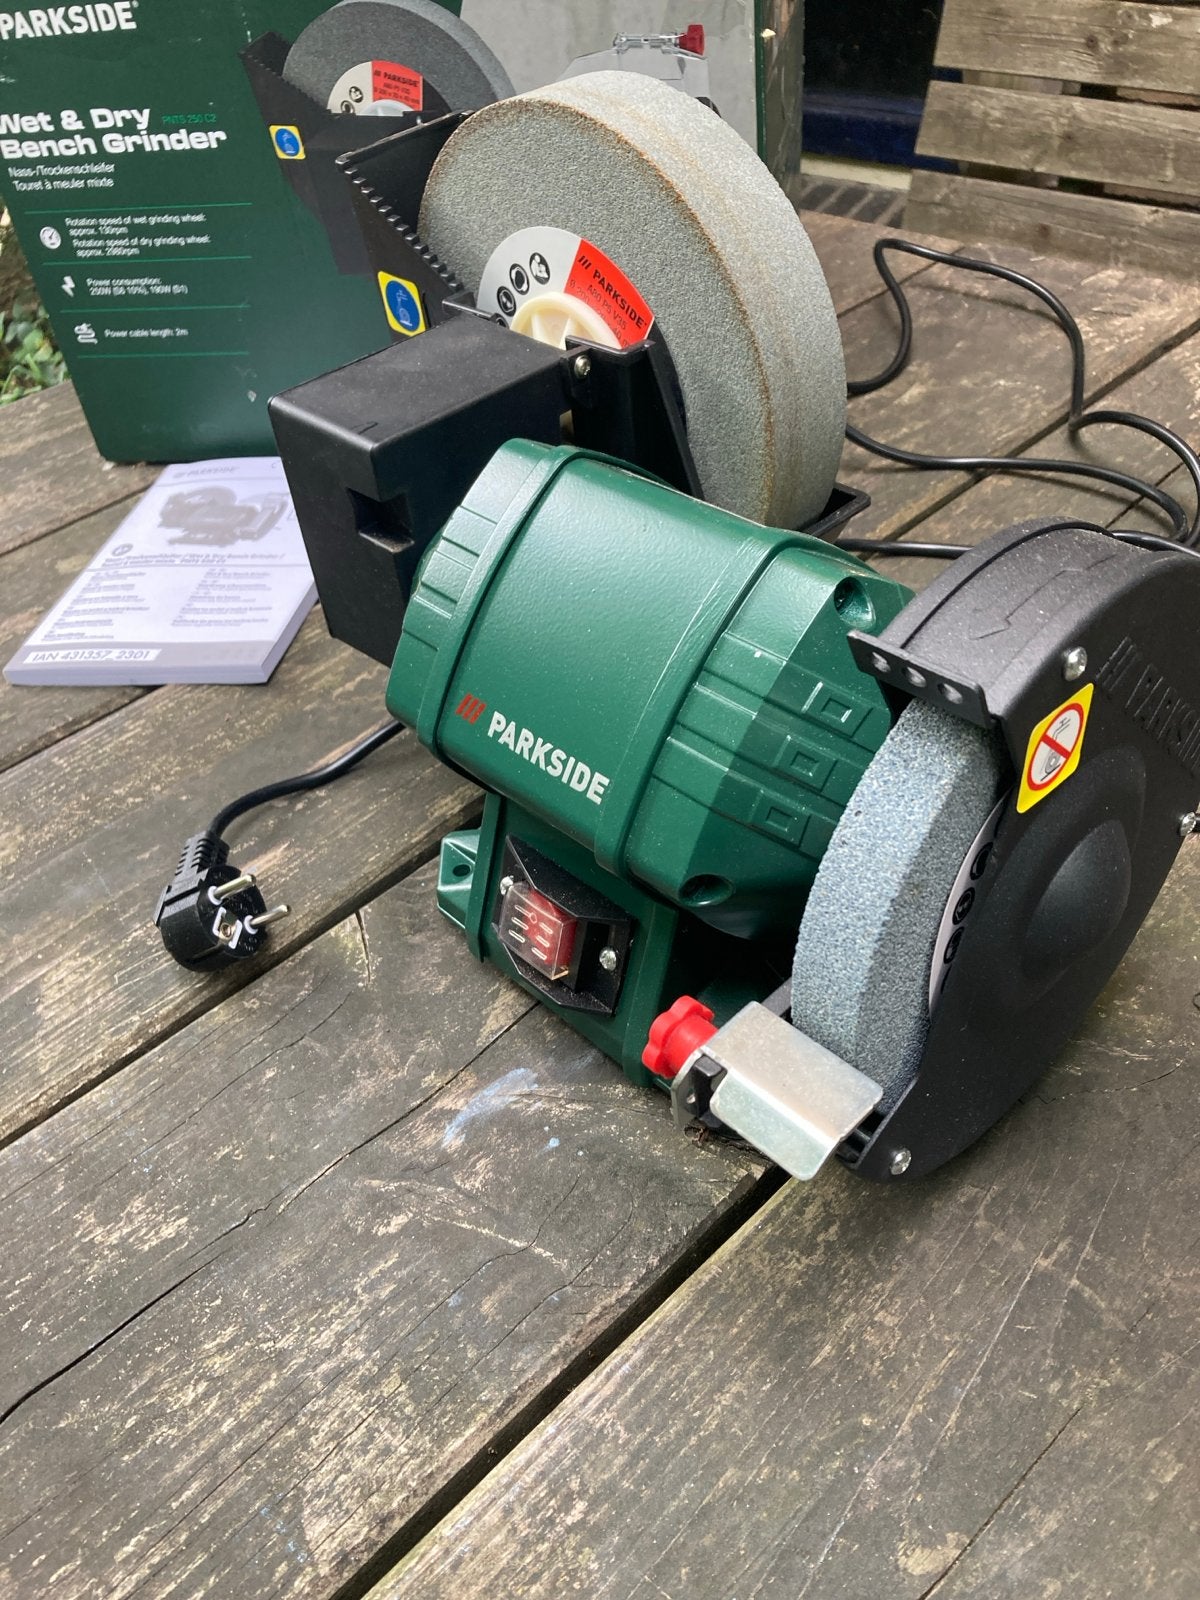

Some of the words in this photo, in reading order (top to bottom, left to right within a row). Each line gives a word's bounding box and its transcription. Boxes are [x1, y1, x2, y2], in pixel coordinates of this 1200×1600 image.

[0, 1, 137, 40] PARKSIDE
[0, 112, 55, 134] Wet
[60, 109, 86, 131] &
[89, 108, 150, 130] Dry
[0, 134, 98, 159] Bench
[102, 129, 227, 154] Grinder
[12, 179, 44, 192] Touret
[593, 269, 647, 329] PARKSIDE
[33, 652, 59, 661] IAN
[1125, 663, 1200, 777] PARKSID
[487, 711, 610, 805] PARKSIDE
